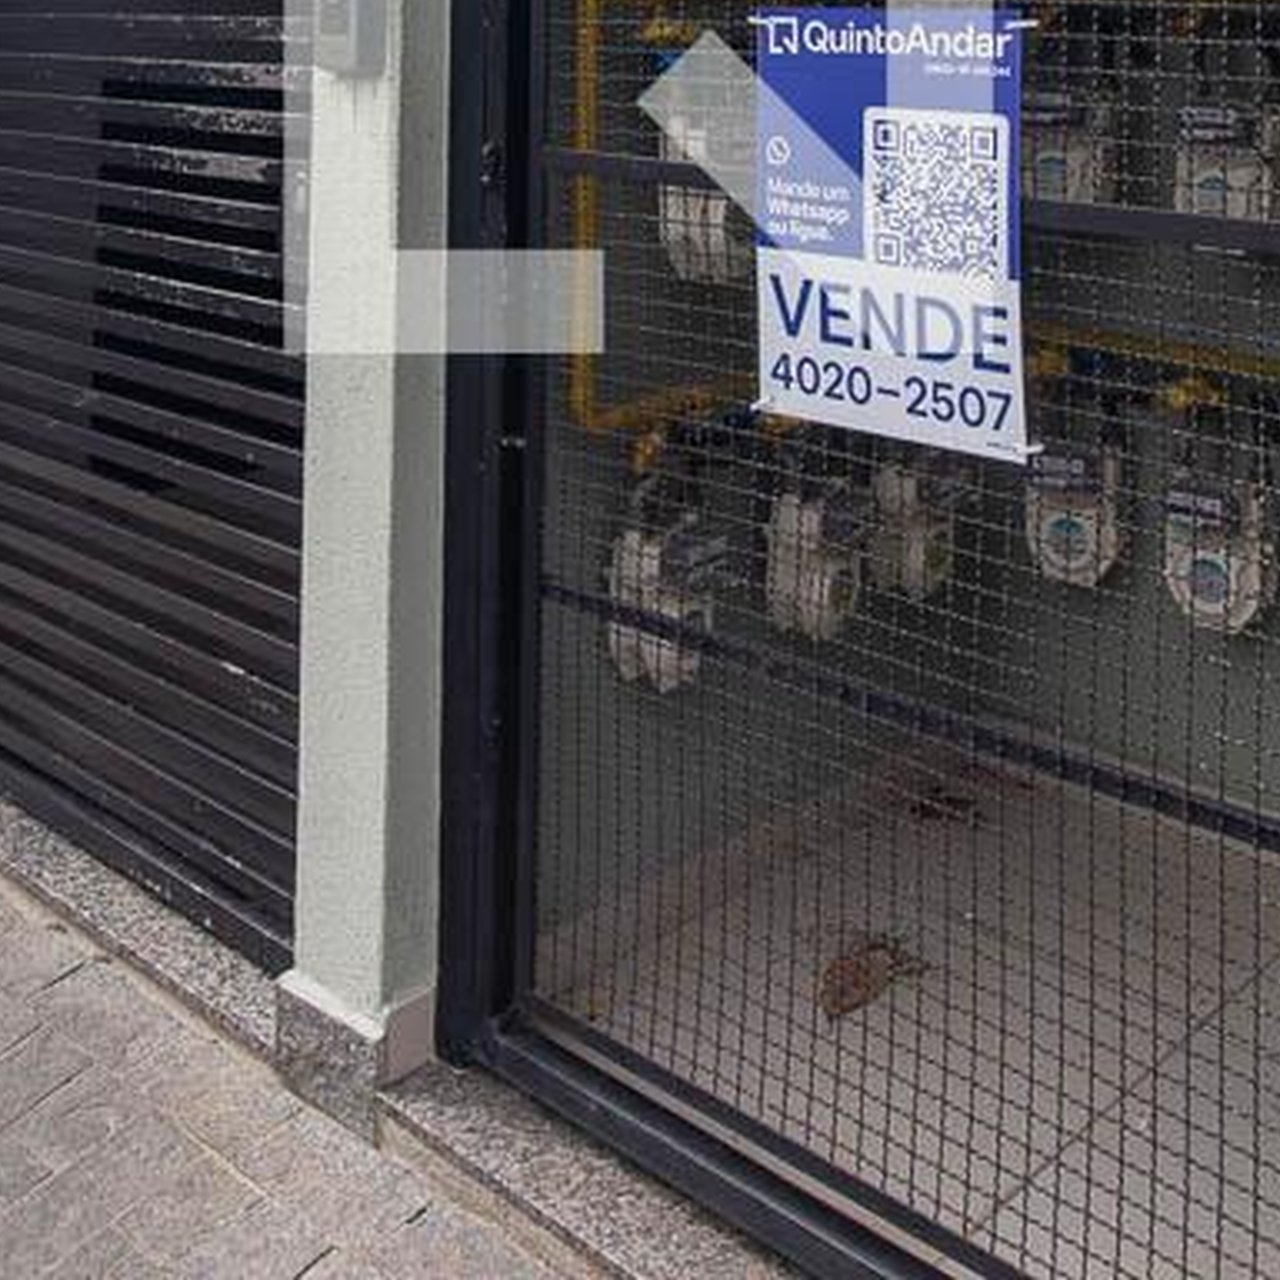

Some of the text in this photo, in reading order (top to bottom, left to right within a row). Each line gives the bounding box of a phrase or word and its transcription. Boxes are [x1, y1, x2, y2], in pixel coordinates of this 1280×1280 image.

[803, 21, 1011, 58] QuintoAndar
[770, 274, 1012, 374] VENDE
[770, 352, 1013, 431] 4020-2507
